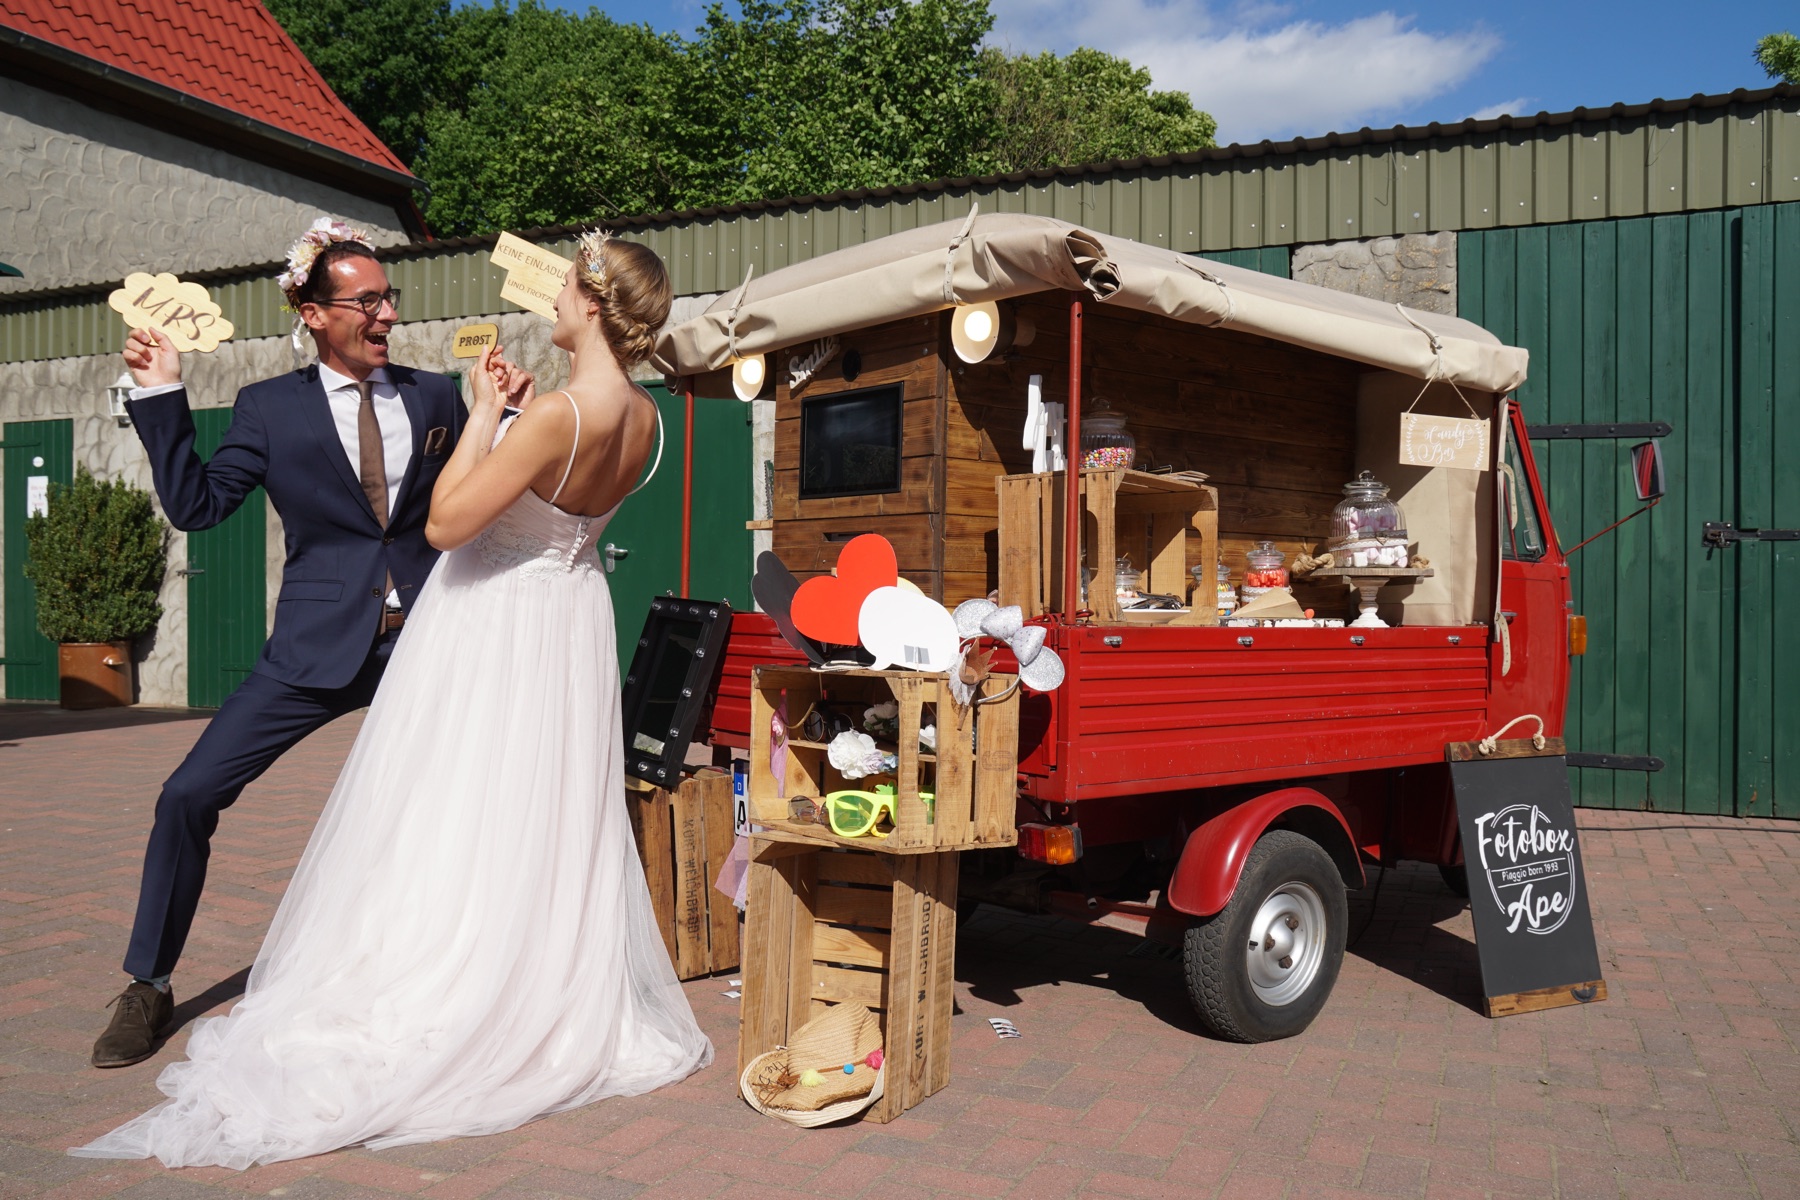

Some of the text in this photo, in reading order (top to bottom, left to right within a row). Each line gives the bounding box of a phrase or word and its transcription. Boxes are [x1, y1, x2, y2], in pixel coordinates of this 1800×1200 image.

[497, 243, 525, 262] KEINE
[507, 279, 526, 292] UND
[132, 286, 216, 341] MRS
[788, 336, 841, 390] Smile
[1424, 421, 1474, 450] Candy
[1418, 442, 1455, 465] Bar
[737, 782, 742, 791] D
[682, 819, 696, 853] KURT
[1474, 804, 1575, 870] Fotobox
[1501, 861, 1559, 882] Piaggio born 1993
[1506, 883, 1567, 934] Ape
[915, 1011, 926, 1061] KURT
